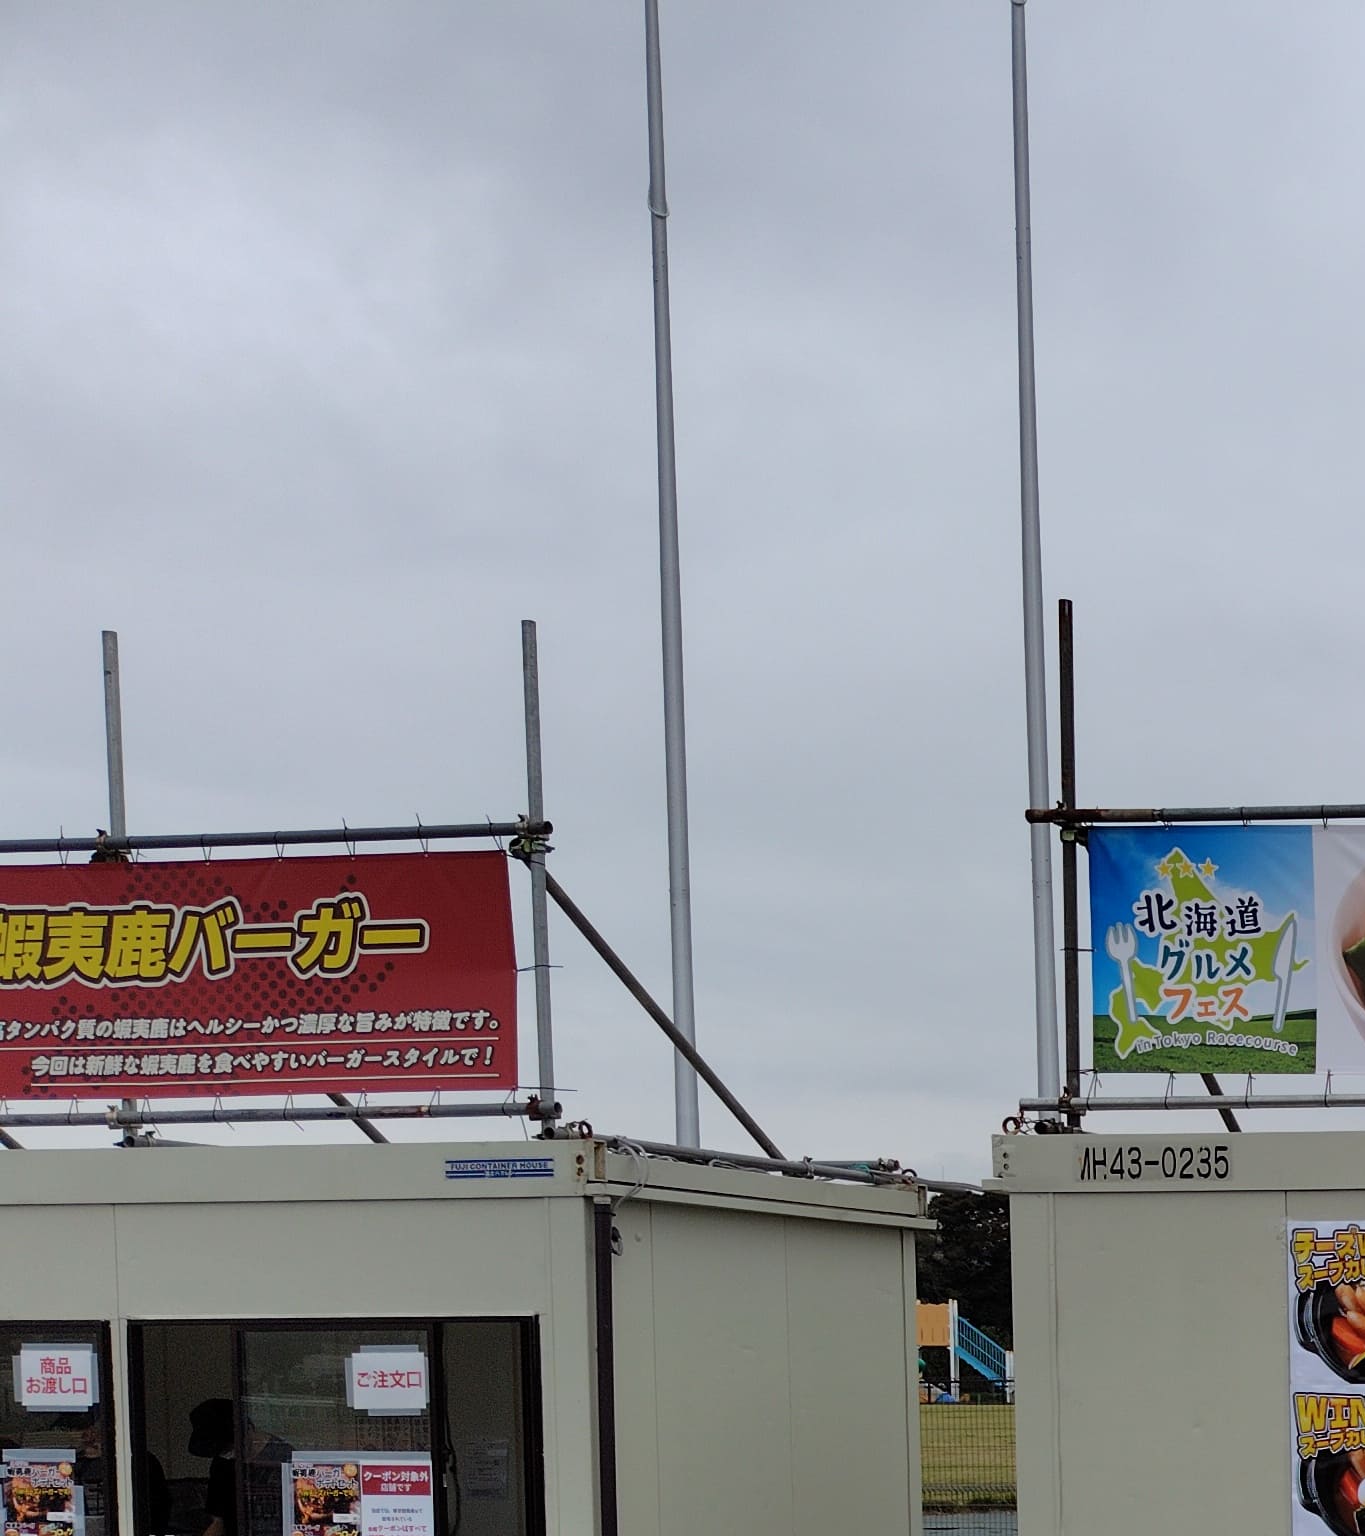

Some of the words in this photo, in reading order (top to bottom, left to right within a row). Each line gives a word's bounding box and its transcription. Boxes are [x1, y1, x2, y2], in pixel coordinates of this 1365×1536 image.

[1133, 892, 1263, 939] 北海道
[1157, 942, 1253, 982] グルメ
[1163, 984, 1250, 1023] フェス
[1135, 1036, 1150, 1054] in
[1150, 1031, 1202, 1053] Tokyo
[1204, 1029, 1299, 1057] Racecourse
[470, 1162, 518, 1171] CONTAINER
[520, 1161, 549, 1170] HOUSE
[40, 1356, 72, 1376] 商品
[26, 1376, 88, 1395] お渡し口
[356, 1369, 423, 1389] ご注文口
[363, 1469, 429, 1484] クーポン対象外
[380, 1483, 412, 1493] 店舗です
